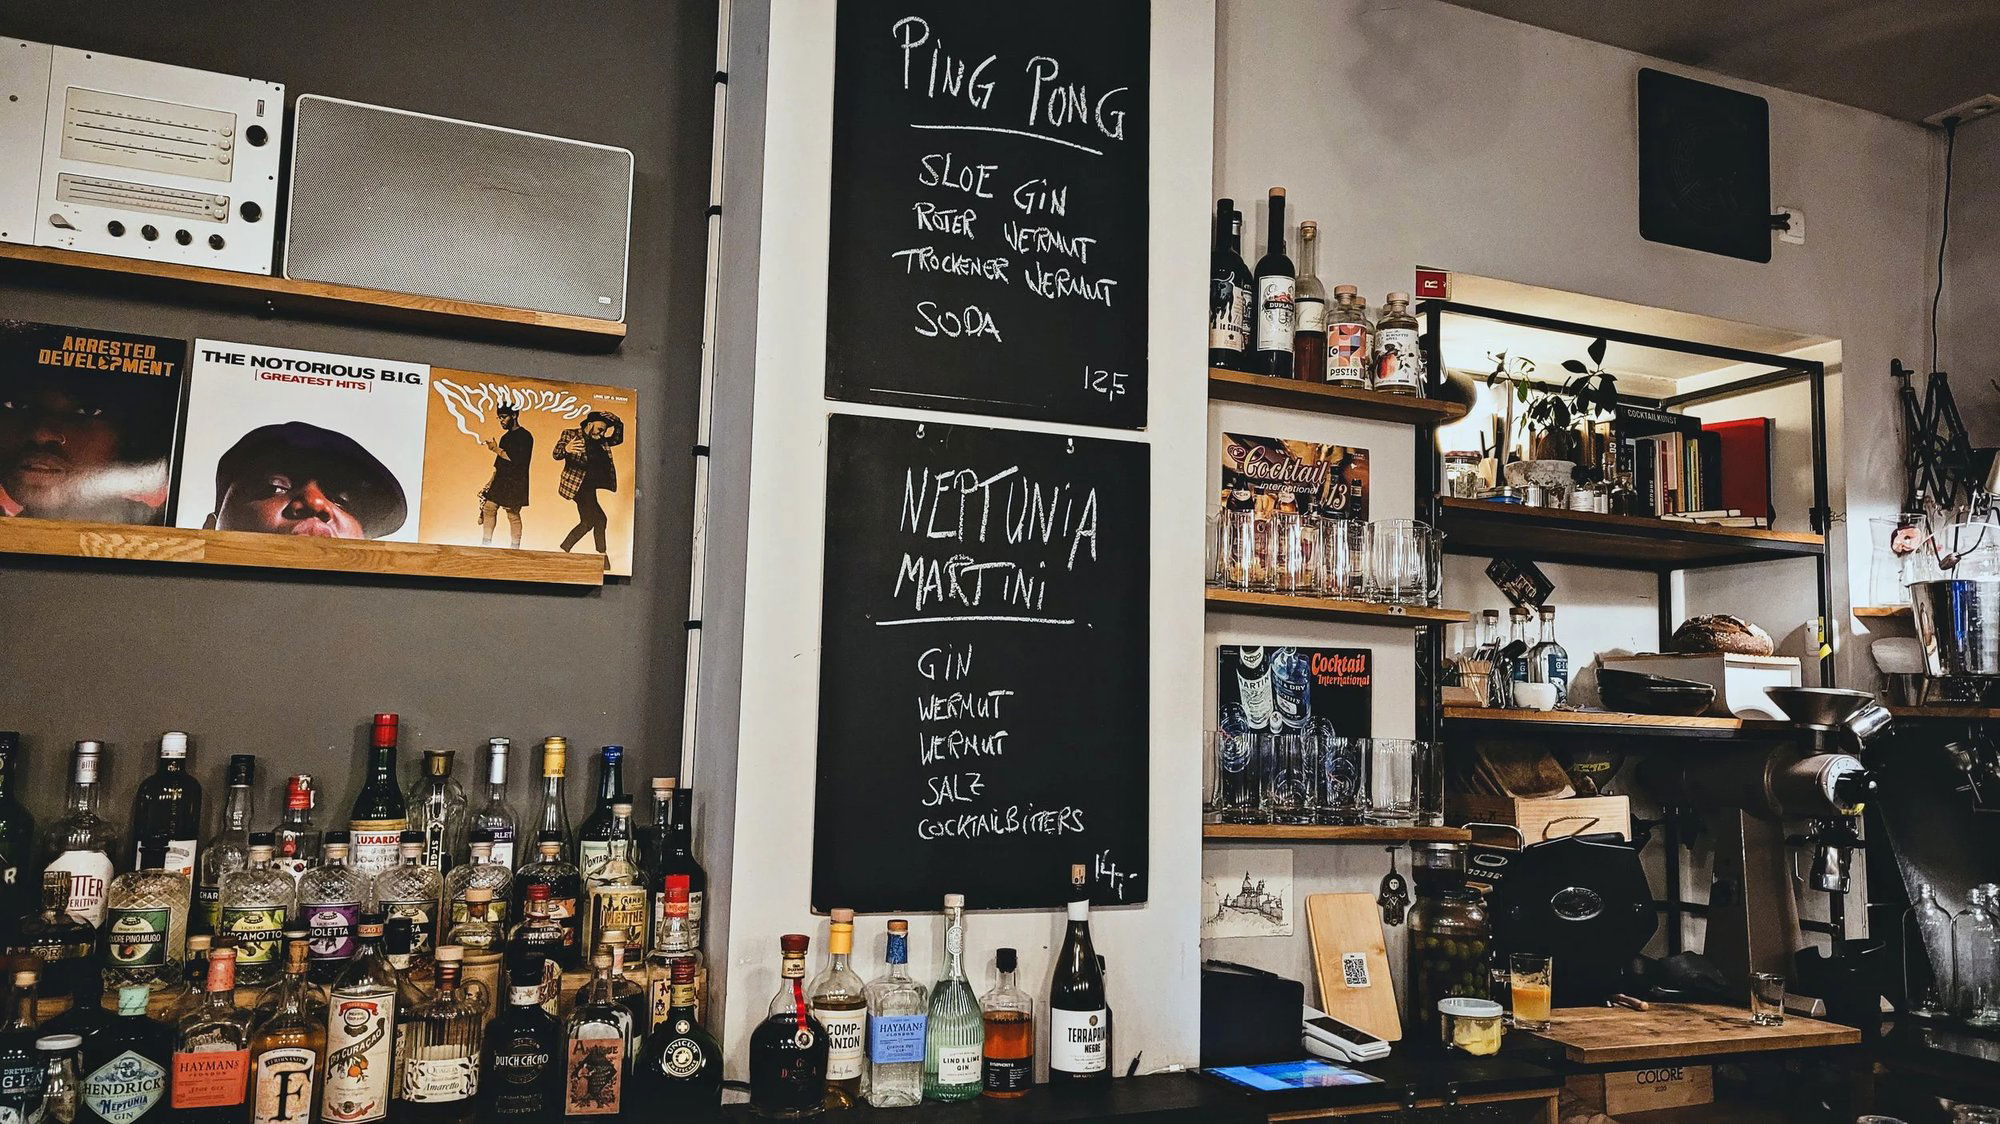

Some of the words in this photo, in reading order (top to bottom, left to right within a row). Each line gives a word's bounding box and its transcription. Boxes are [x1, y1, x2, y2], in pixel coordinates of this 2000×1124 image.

[1025, 55, 1129, 142] PONG
[918, 152, 999, 199] SLOE
[911, 201, 977, 241] ROTER
[1003, 220, 1097, 266] WERMUT
[891, 246, 1010, 285] TROCKENER
[1024, 260, 1118, 307] WERMUT
[914, 301, 1003, 343] SODA
[62, 335, 156, 360] ARRESTED
[202, 349, 245, 366] THE
[250, 355, 375, 380] NOTORIOUS
[380, 369, 423, 386] B.I.G.
[1084, 365, 1129, 402] 12,5
[1627, 409, 1677, 425] COCKTAILKUNST
[1227, 445, 1329, 485] Cocktail
[1328, 483, 1348, 510] 13
[1311, 652, 1366, 677] Cocktail
[917, 689, 1015, 722] WERMUT
[919, 729, 1009, 767] WERMUT
[921, 772, 985, 807] SALZ
[141, 933, 161, 943] MUGO
[310, 927, 349, 938] IOLETTA
[495, 1055, 520, 1067] DUTCH
[520, 1054, 549, 1067] CACAO
[667, 1040, 698, 1055] UNICUM
[1636, 1067, 1683, 1085] COLORE
[100, 1095, 148, 1115] NEPTUNIA
[114, 1111, 134, 1120] GIN
